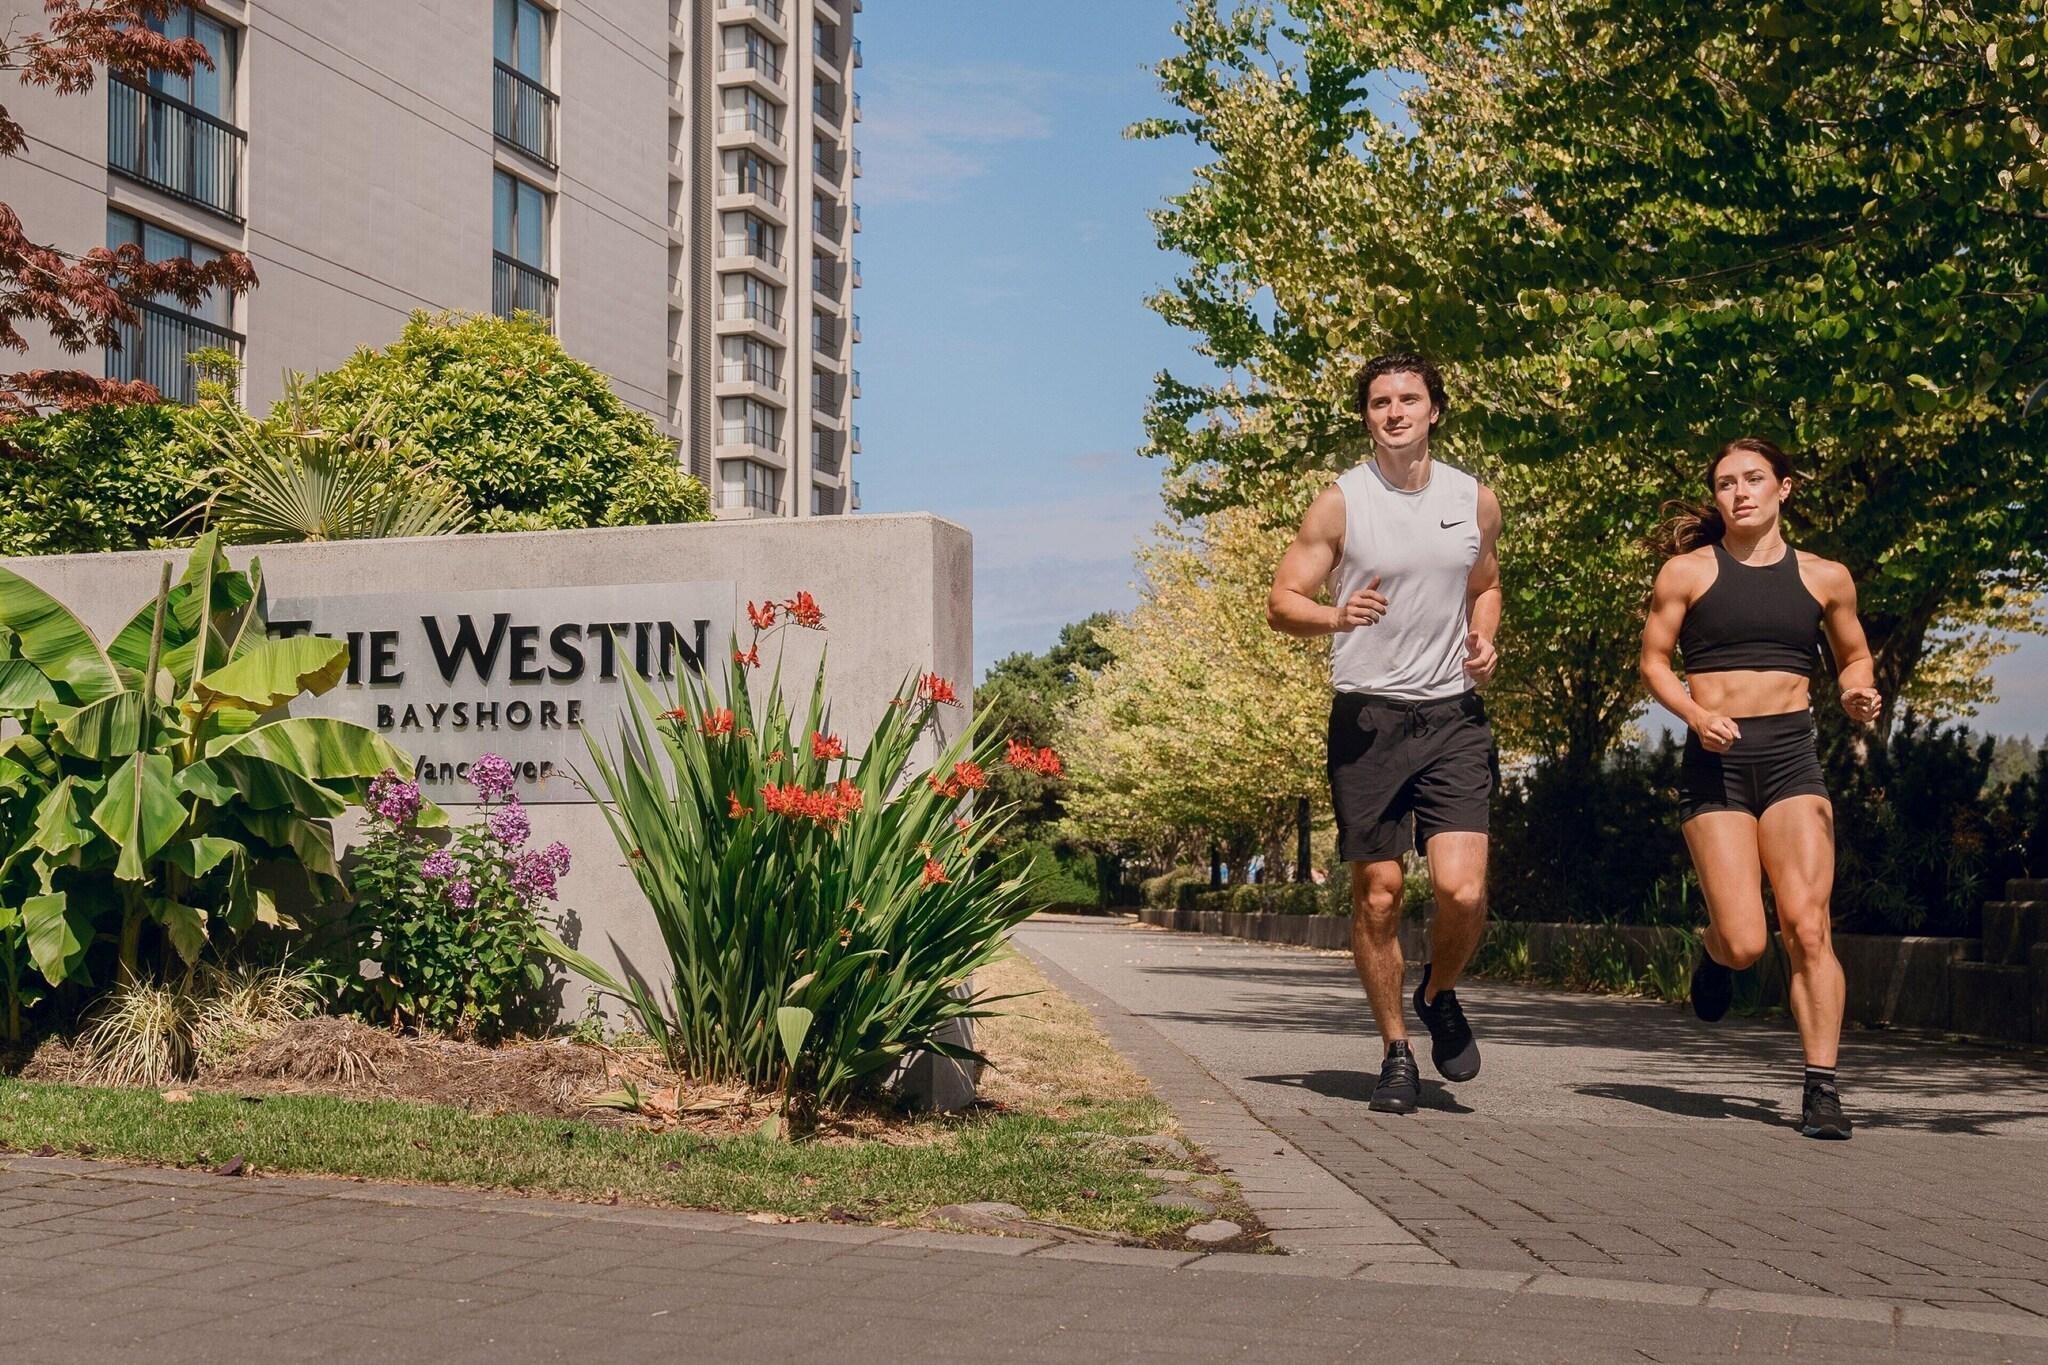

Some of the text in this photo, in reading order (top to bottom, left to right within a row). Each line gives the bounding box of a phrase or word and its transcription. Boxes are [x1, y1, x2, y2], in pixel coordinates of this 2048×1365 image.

[420, 612, 711, 686] WESTIN
[377, 699, 584, 729] BAYSHORE
[414, 755, 554, 779] ancver
